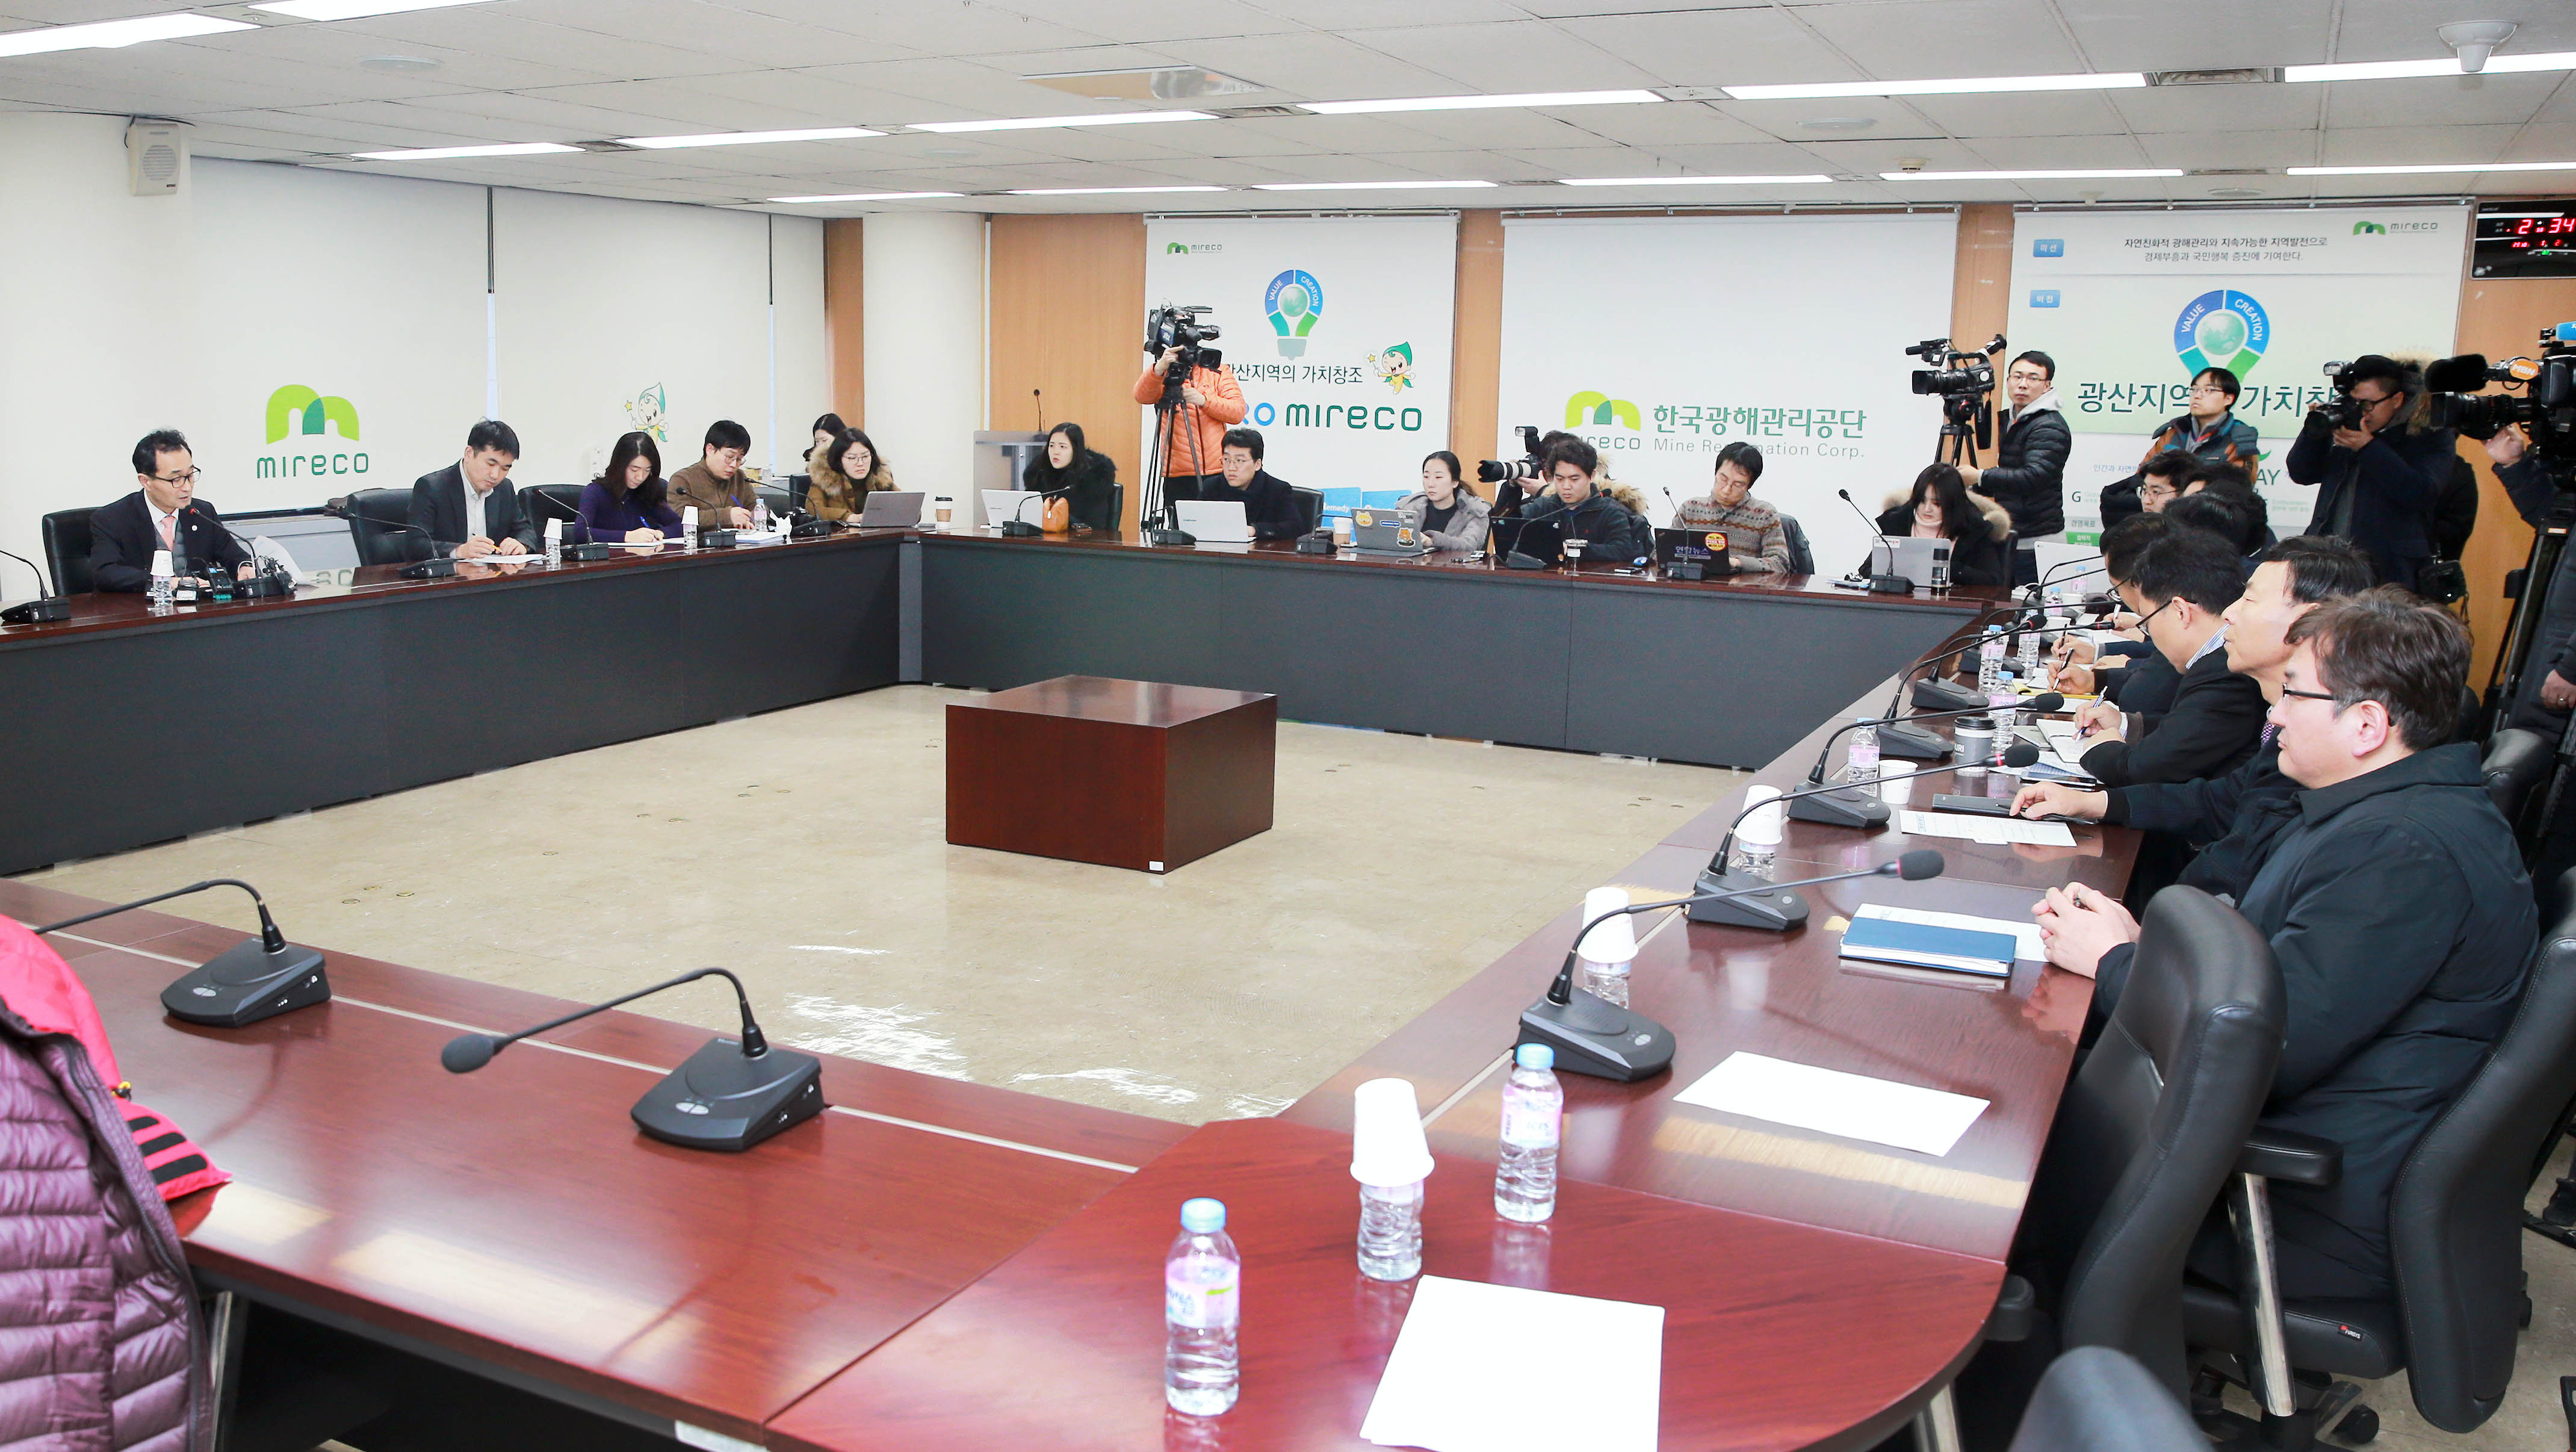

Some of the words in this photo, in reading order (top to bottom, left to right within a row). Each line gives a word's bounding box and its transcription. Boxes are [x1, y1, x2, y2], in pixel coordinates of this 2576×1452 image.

[2125, 238, 2169, 248] 자연친화적
[2173, 238, 2217, 248] 광해관리와
[2221, 238, 2267, 247] 지속가능한
[2271, 237, 2327, 247] 지역발전으로
[2144, 252, 2189, 261] 경제부흥과
[2193, 252, 2228, 261] 국민행복
[2232, 252, 2259, 261] 증진에
[2264, 252, 2303, 261] 기여한다.
[1269, 279, 1283, 301] VALUE
[1301, 276, 1319, 307] CREATION
[2181, 303, 2205, 332] VALUE
[2235, 299, 2263, 341] CREATION
[1227, 364, 1295, 382] 산지역의
[1302, 365, 1363, 384] 가치창조
[2512, 364, 2536, 376] MBN
[2241, 385, 2336, 418] 가치창
[1286, 403, 1422, 431] mireco
[1653, 405, 1866, 438] 한국광해관리공단
[1581, 436, 1640, 450] reco
[1655, 438, 1694, 452] Mine
[1817, 443, 1865, 460] Corp.
[257, 453, 368, 479] mireco
